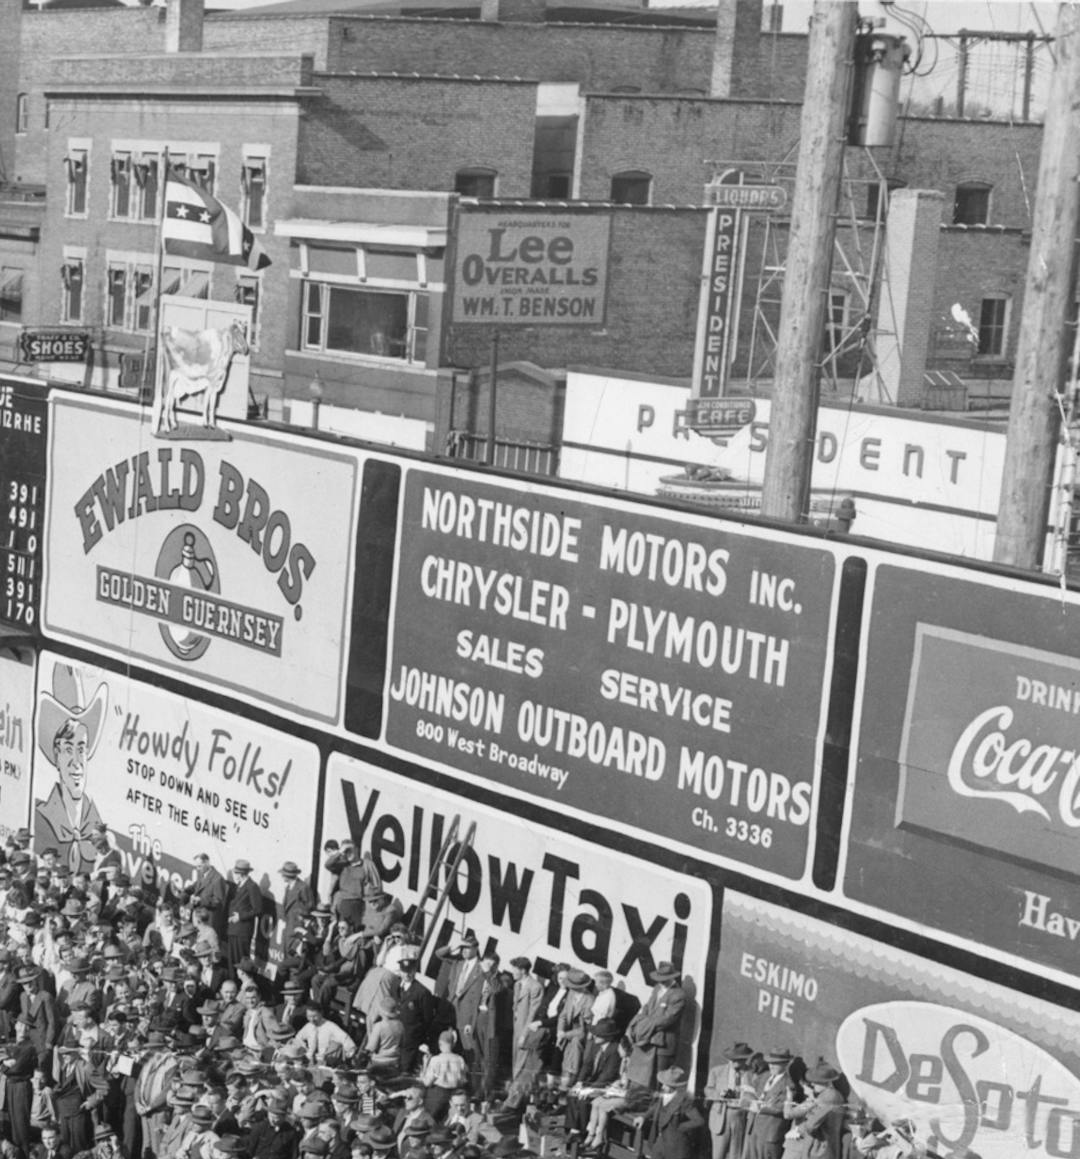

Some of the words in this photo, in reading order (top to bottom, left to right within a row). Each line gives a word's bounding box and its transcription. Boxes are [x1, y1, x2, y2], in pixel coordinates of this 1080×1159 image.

[462, 253, 599, 286] OVERALLS
[486, 228, 574, 265] Lee
[462, 297, 499, 316] WM.
[503, 297, 514, 316] T.
[520, 297, 596, 317] BENSON
[703, 214, 733, 391] PRESIDENT
[31, 340, 84, 355] SHOES
[637, 403, 968, 485] PRSDENT
[697, 409, 750, 424] CAFE
[73, 447, 206, 556] EWALD
[212, 459, 317, 622] BROS.
[421, 486, 582, 563] NORTHSIDE
[599, 525, 730, 597] MOTORS
[749, 569, 803, 615] INC.
[99, 571, 171, 616] GOLDEN
[182, 594, 281, 651] GUERNSEY
[421, 554, 570, 631] CHRYSLER
[607, 598, 790, 688] PLYMOUTH
[456, 629, 545, 678] SALES
[600, 669, 733, 733] SERVICE
[208, 728, 293, 810] Folks!
[390, 665, 506, 734] JOHNSON
[517, 700, 667, 782] OUTBOARD
[677, 746, 813, 826] MOTORS
[416, 719, 444, 743] 800
[447, 727, 485, 758] West
[489, 742, 569, 790] Broadway
[126, 758, 155, 782] STOP
[159, 771, 193, 798] DOWN
[196, 786, 220, 808] AND
[224, 797, 248, 821] SEE
[253, 808, 270, 829] US
[126, 788, 163, 816] AFTER
[168, 800, 189, 827] THE
[691, 807, 719, 833] Ch.
[725, 815, 773, 849] 3336
[128, 823, 161, 860] The
[340, 777, 535, 937] Yellow
[541, 851, 692, 989] Taxi
[739, 952, 819, 1003] ESKIMO
[757, 990, 796, 1025] PIE
